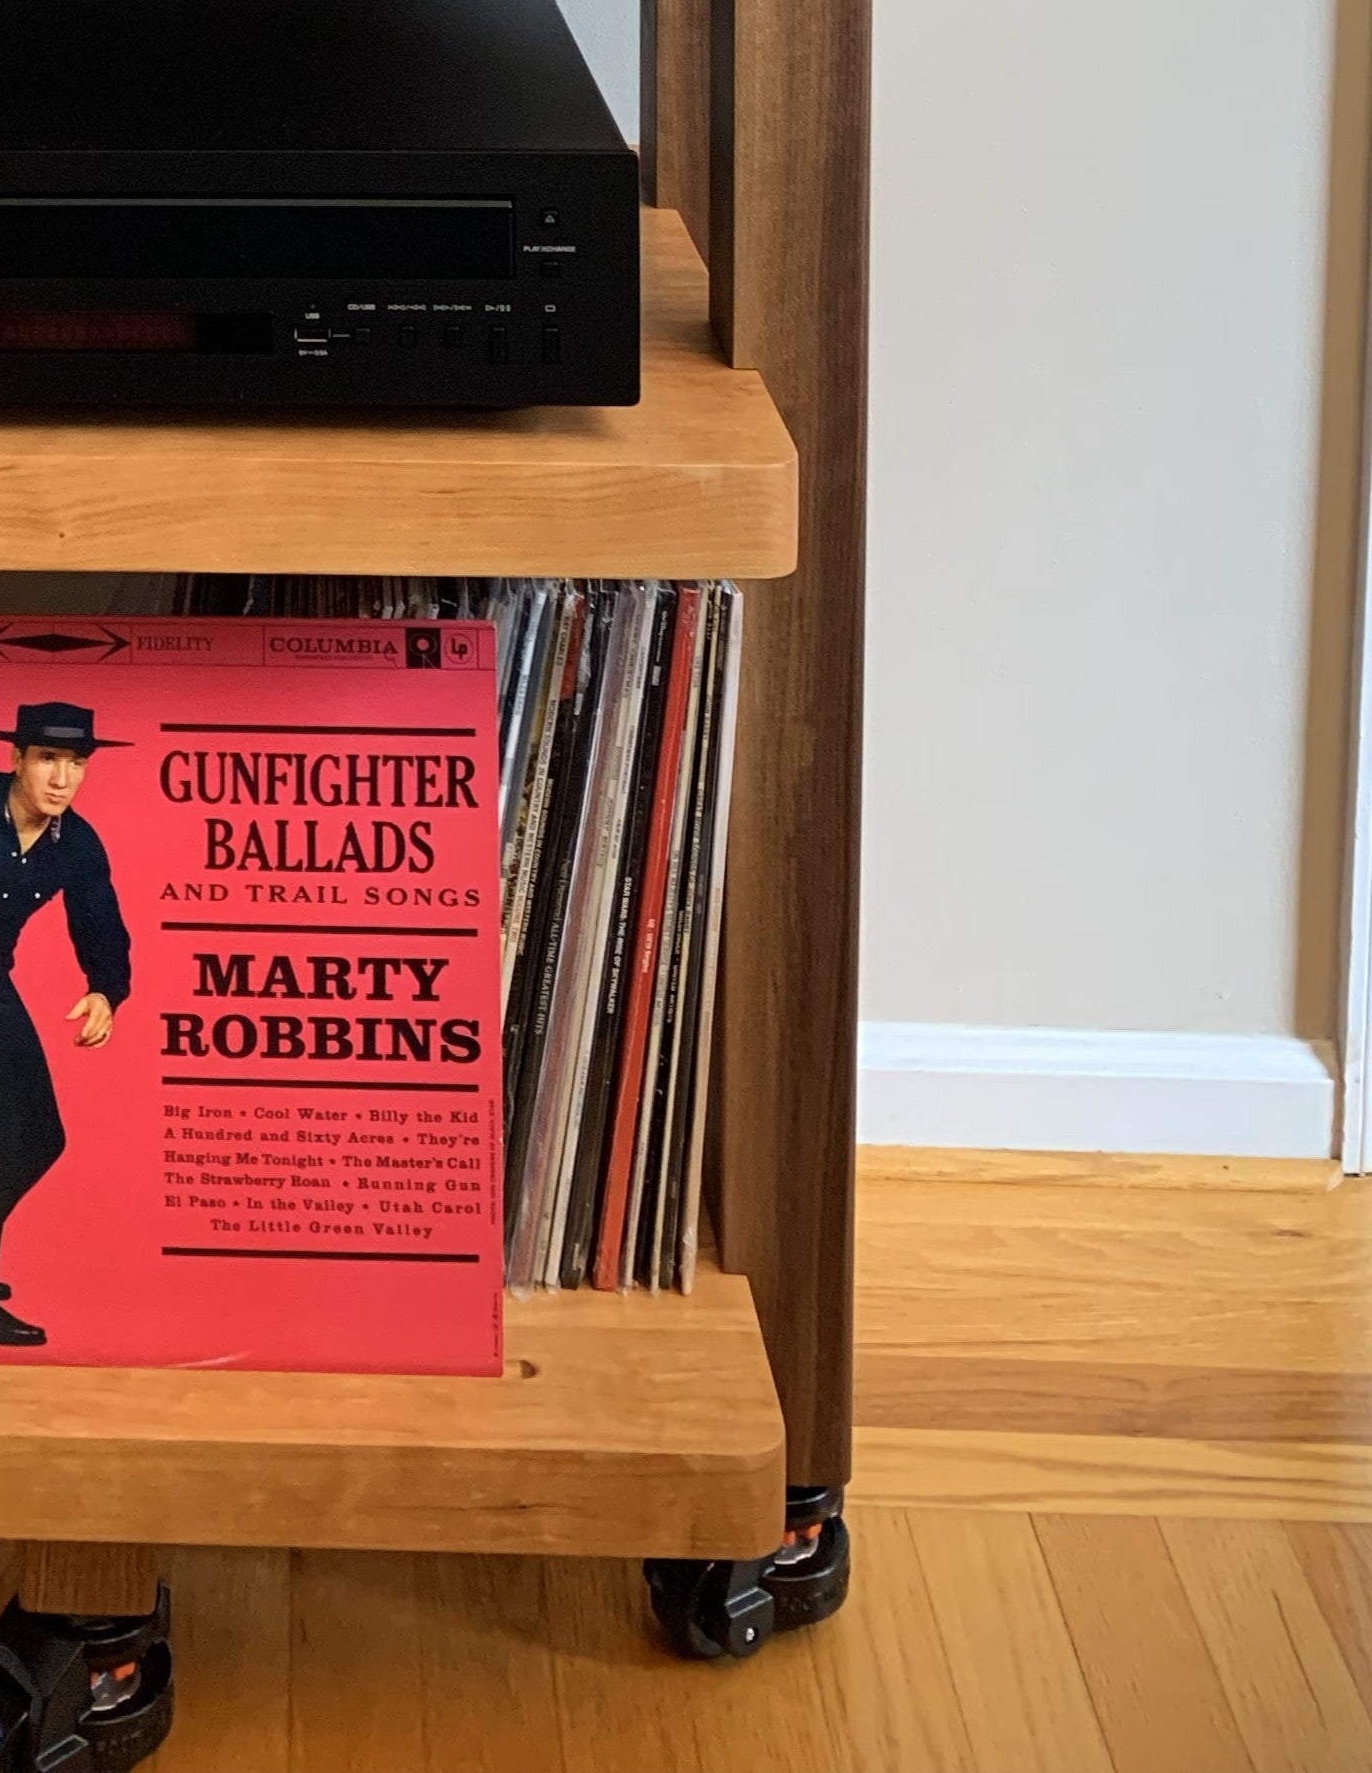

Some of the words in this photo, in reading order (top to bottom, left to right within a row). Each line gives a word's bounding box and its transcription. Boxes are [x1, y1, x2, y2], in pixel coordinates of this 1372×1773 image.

[136, 636, 213, 652] FIDELITY
[269, 637, 398, 655] COLUMBIA
[555, 632, 568, 666] CHARLES
[544, 700, 556, 732] MODERN
[539, 734, 551, 766] SOUNDS
[160, 751, 479, 808] GUNFIGHTER
[538, 767, 546, 776] IN
[531, 778, 543, 813] COUNTRY
[543, 778, 554, 808] MODERN
[528, 814, 538, 831] AND
[538, 809, 548, 839] SOUNDS
[204, 819, 434, 873] BALLADS
[522, 832, 534, 868] WESTERN
[530, 849, 541, 882] COUNTRY
[518, 870, 528, 893] MUSIC
[527, 883, 535, 898] AND
[623, 877, 632, 896] STAR
[160, 883, 228, 901] AND
[245, 885, 347, 904] TRAIL
[364, 887, 480, 907] SONGS
[513, 895, 524, 926] VOLUME
[521, 900, 532, 932] WESTERN
[510, 928, 519, 943] TWO
[617, 922, 626, 936] THE
[545, 922, 559, 963] ALL-TIME
[614, 938, 623, 955] RISE
[613, 956, 621, 966] OF
[193, 954, 449, 1001] MARTY
[538, 965, 554, 1012] GREATEST
[607, 968, 619, 1014] SKYWALKER
[534, 1013, 546, 1035] HITS
[160, 1013, 481, 1063] ROBBINS
[164, 1105, 191, 1120] Big
[198, 1106, 233, 1118] Iron
[254, 1107, 289, 1119] Cool
[297, 1108, 348, 1121] Water
[369, 1110, 409, 1125] Billy
[416, 1111, 442, 1123] the
[450, 1111, 479, 1123] Kid
[164, 1128, 175, 1138] A
[182, 1128, 252, 1141] Hundred
[260, 1130, 289, 1142] and
[297, 1130, 341, 1146] Sixty
[347, 1132, 394, 1144] Acres
[164, 1151, 231, 1167] Hanging
[236, 1153, 258, 1165] Me
[261, 1154, 324, 1169] Tonight
[342, 1155, 372, 1167] The
[376, 1156, 443, 1169] Master's
[447, 1157, 480, 1169] Call
[164, 1172, 194, 1184] The
[201, 1173, 286, 1189] Strawberry
[290, 1175, 331, 1187] Roan
[356, 1178, 436, 1193] Running
[445, 1180, 481, 1191] Gun
[189, 1196, 226, 1208] Paso
[246, 1197, 263, 1209] In
[270, 1199, 296, 1210] the
[303, 1199, 354, 1215] Valley
[379, 1201, 423, 1213] Utah
[432, 1202, 481, 1214] Carol
[210, 1219, 240, 1231] The
[248, 1220, 301, 1232] Little
[309, 1221, 364, 1234] Green
[373, 1223, 433, 1239] Valley
